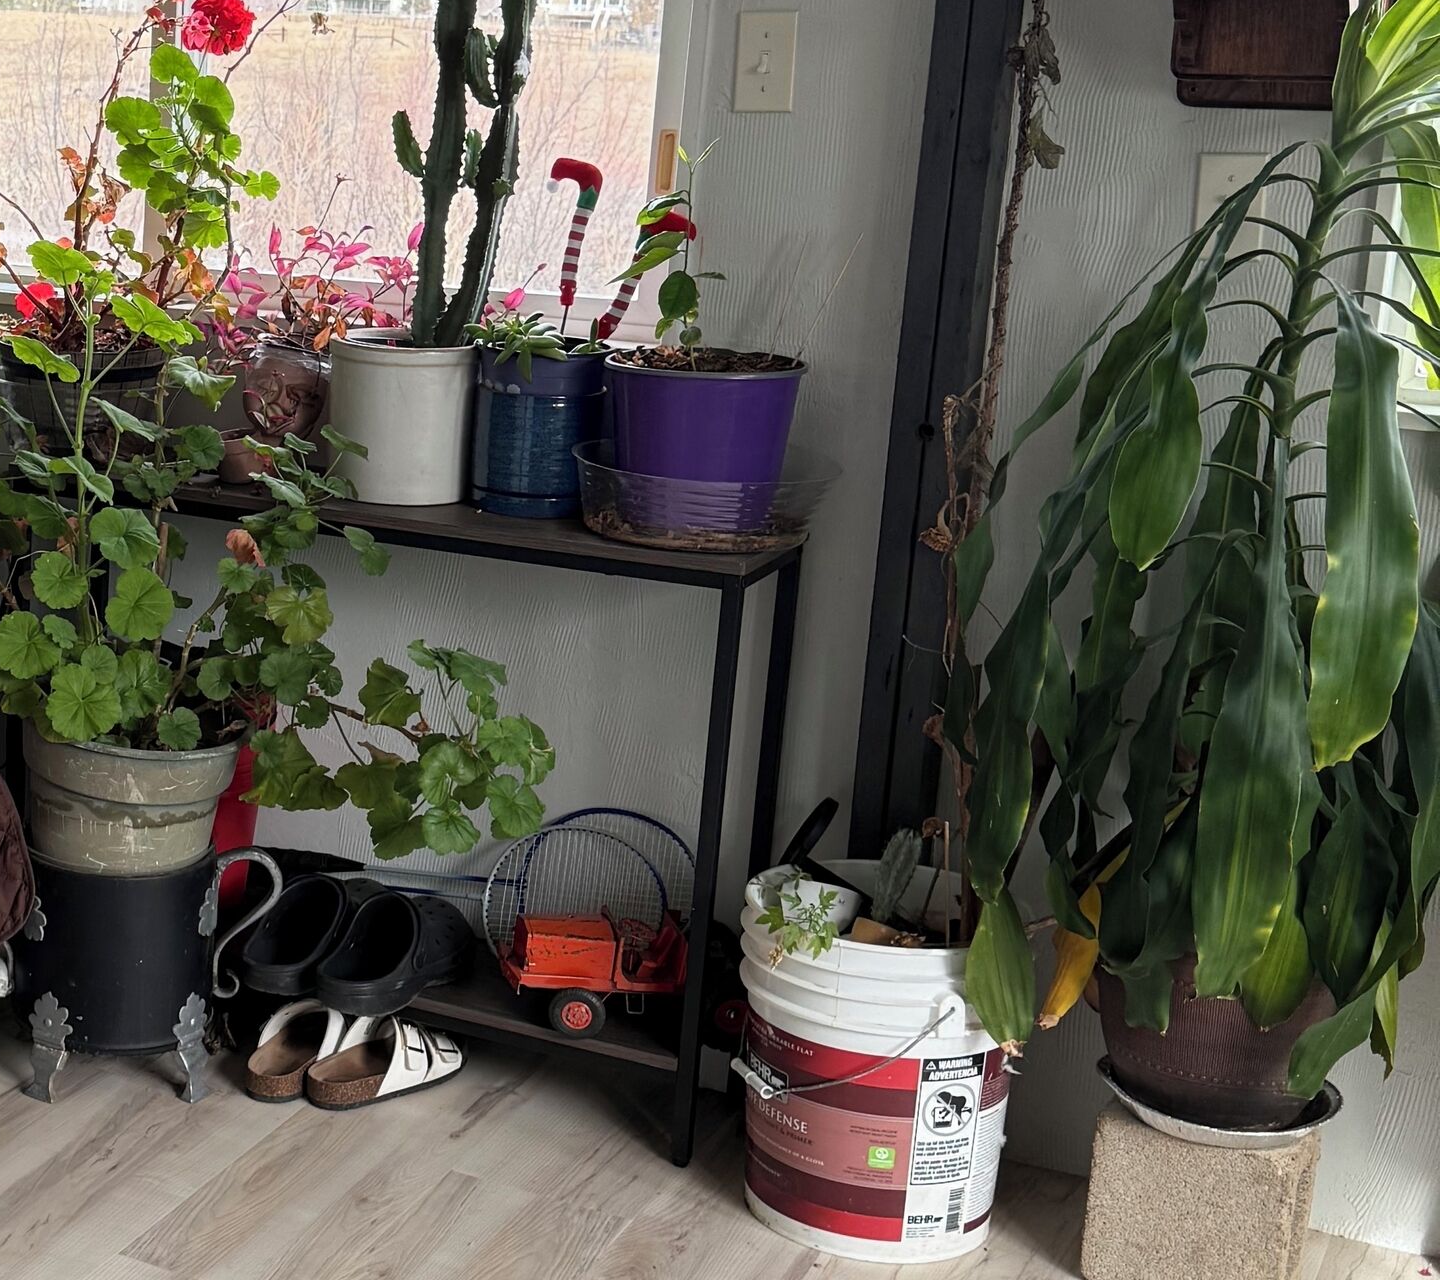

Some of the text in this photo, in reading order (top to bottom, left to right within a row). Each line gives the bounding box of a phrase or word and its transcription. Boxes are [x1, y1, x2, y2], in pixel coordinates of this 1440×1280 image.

[939, 1057, 973, 1070] WARNING
[928, 1066, 979, 1081] ADVERTENCIA
[759, 1099, 809, 1135] DEFENSE
[907, 1215, 934, 1224] BEHR
